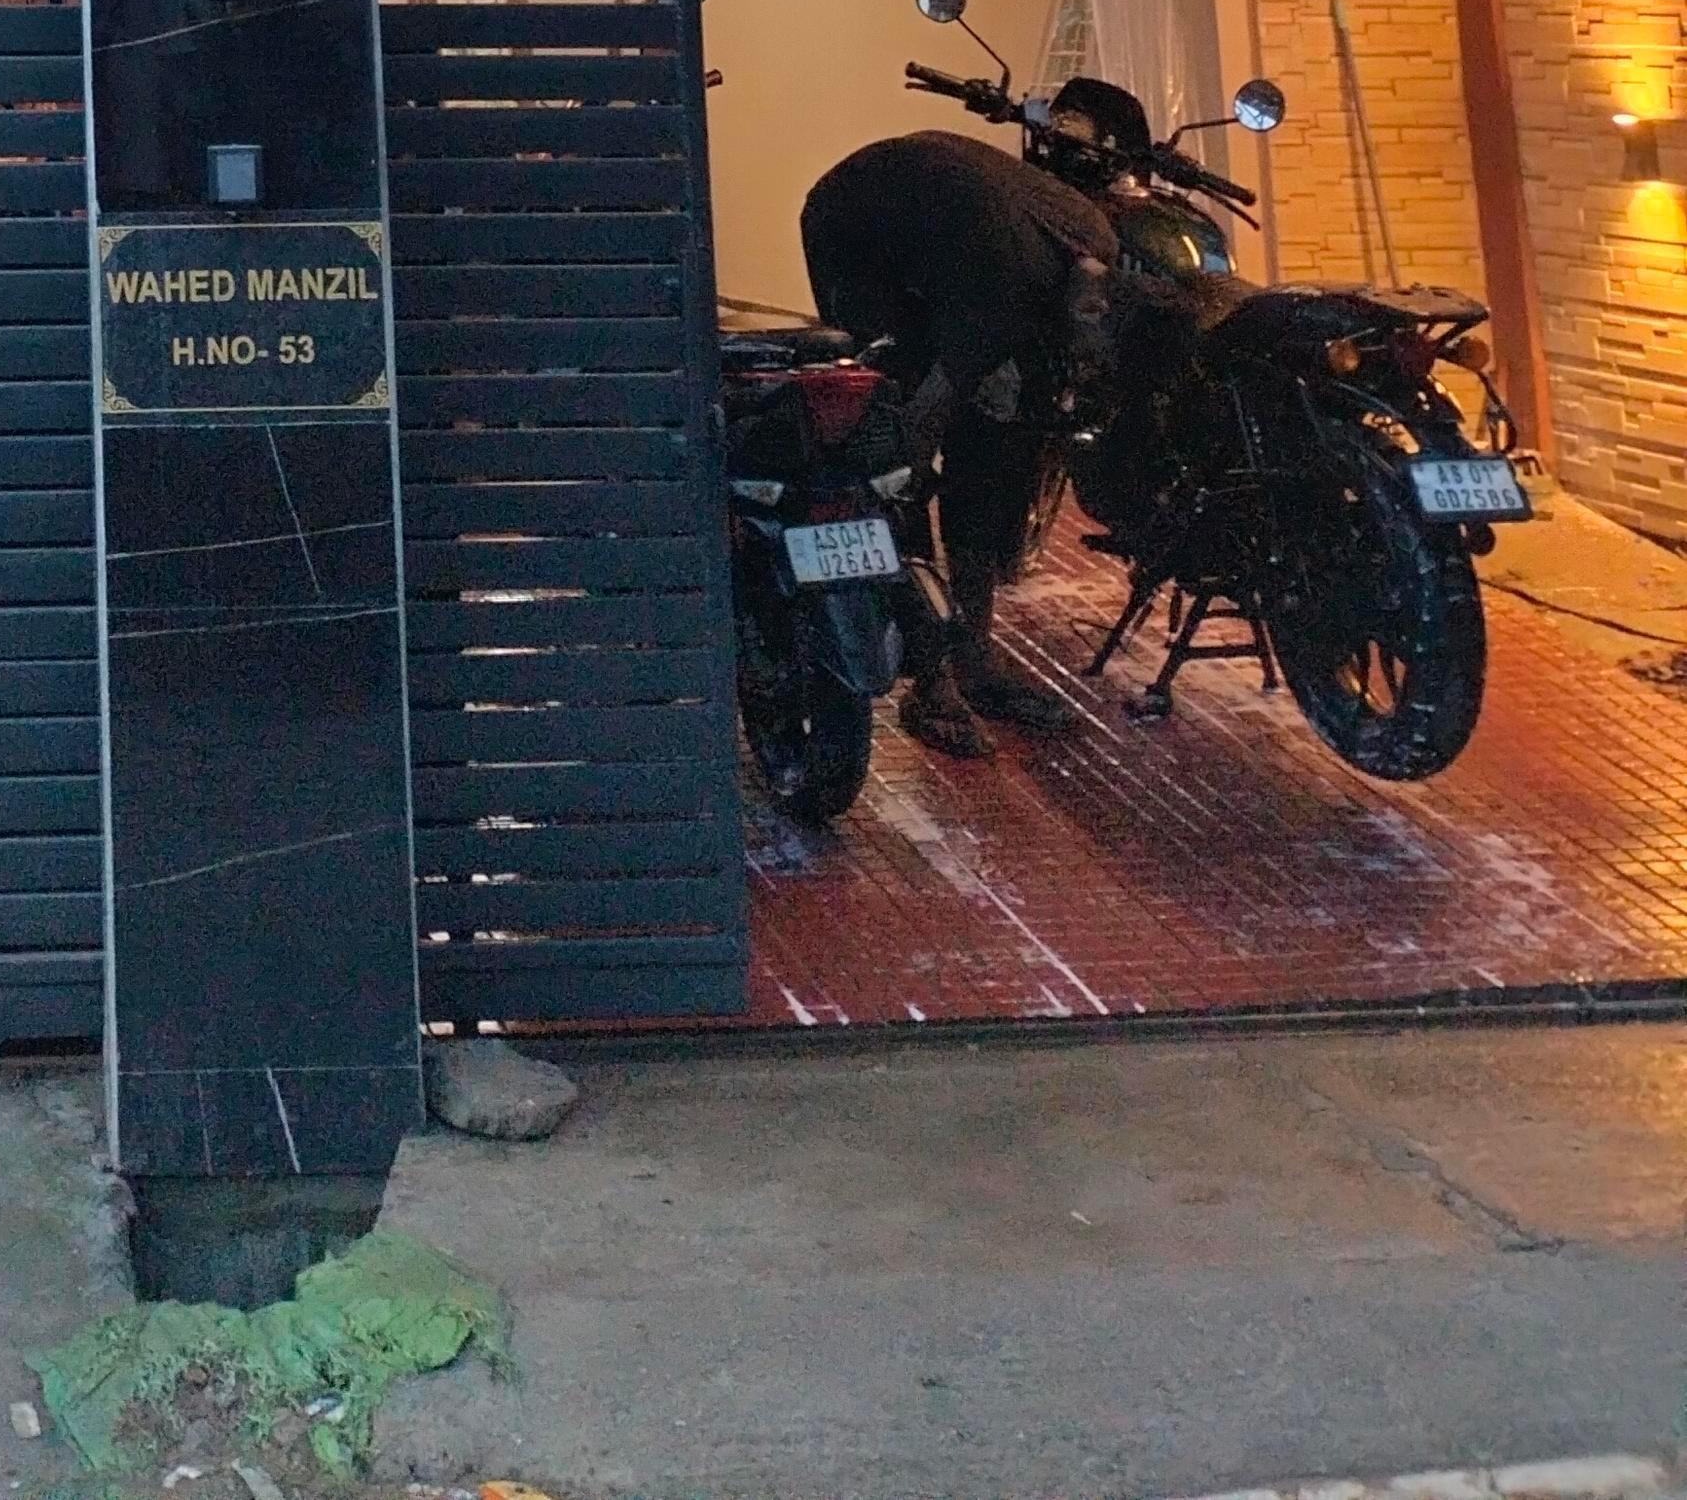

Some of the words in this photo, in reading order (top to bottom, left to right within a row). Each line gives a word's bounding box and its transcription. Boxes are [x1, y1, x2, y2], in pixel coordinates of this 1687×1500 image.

[107, 268, 236, 304] WAHED
[247, 267, 379, 301] MANZIL
[172, 336, 269, 366] H.NO-
[278, 335, 316, 365] 53
